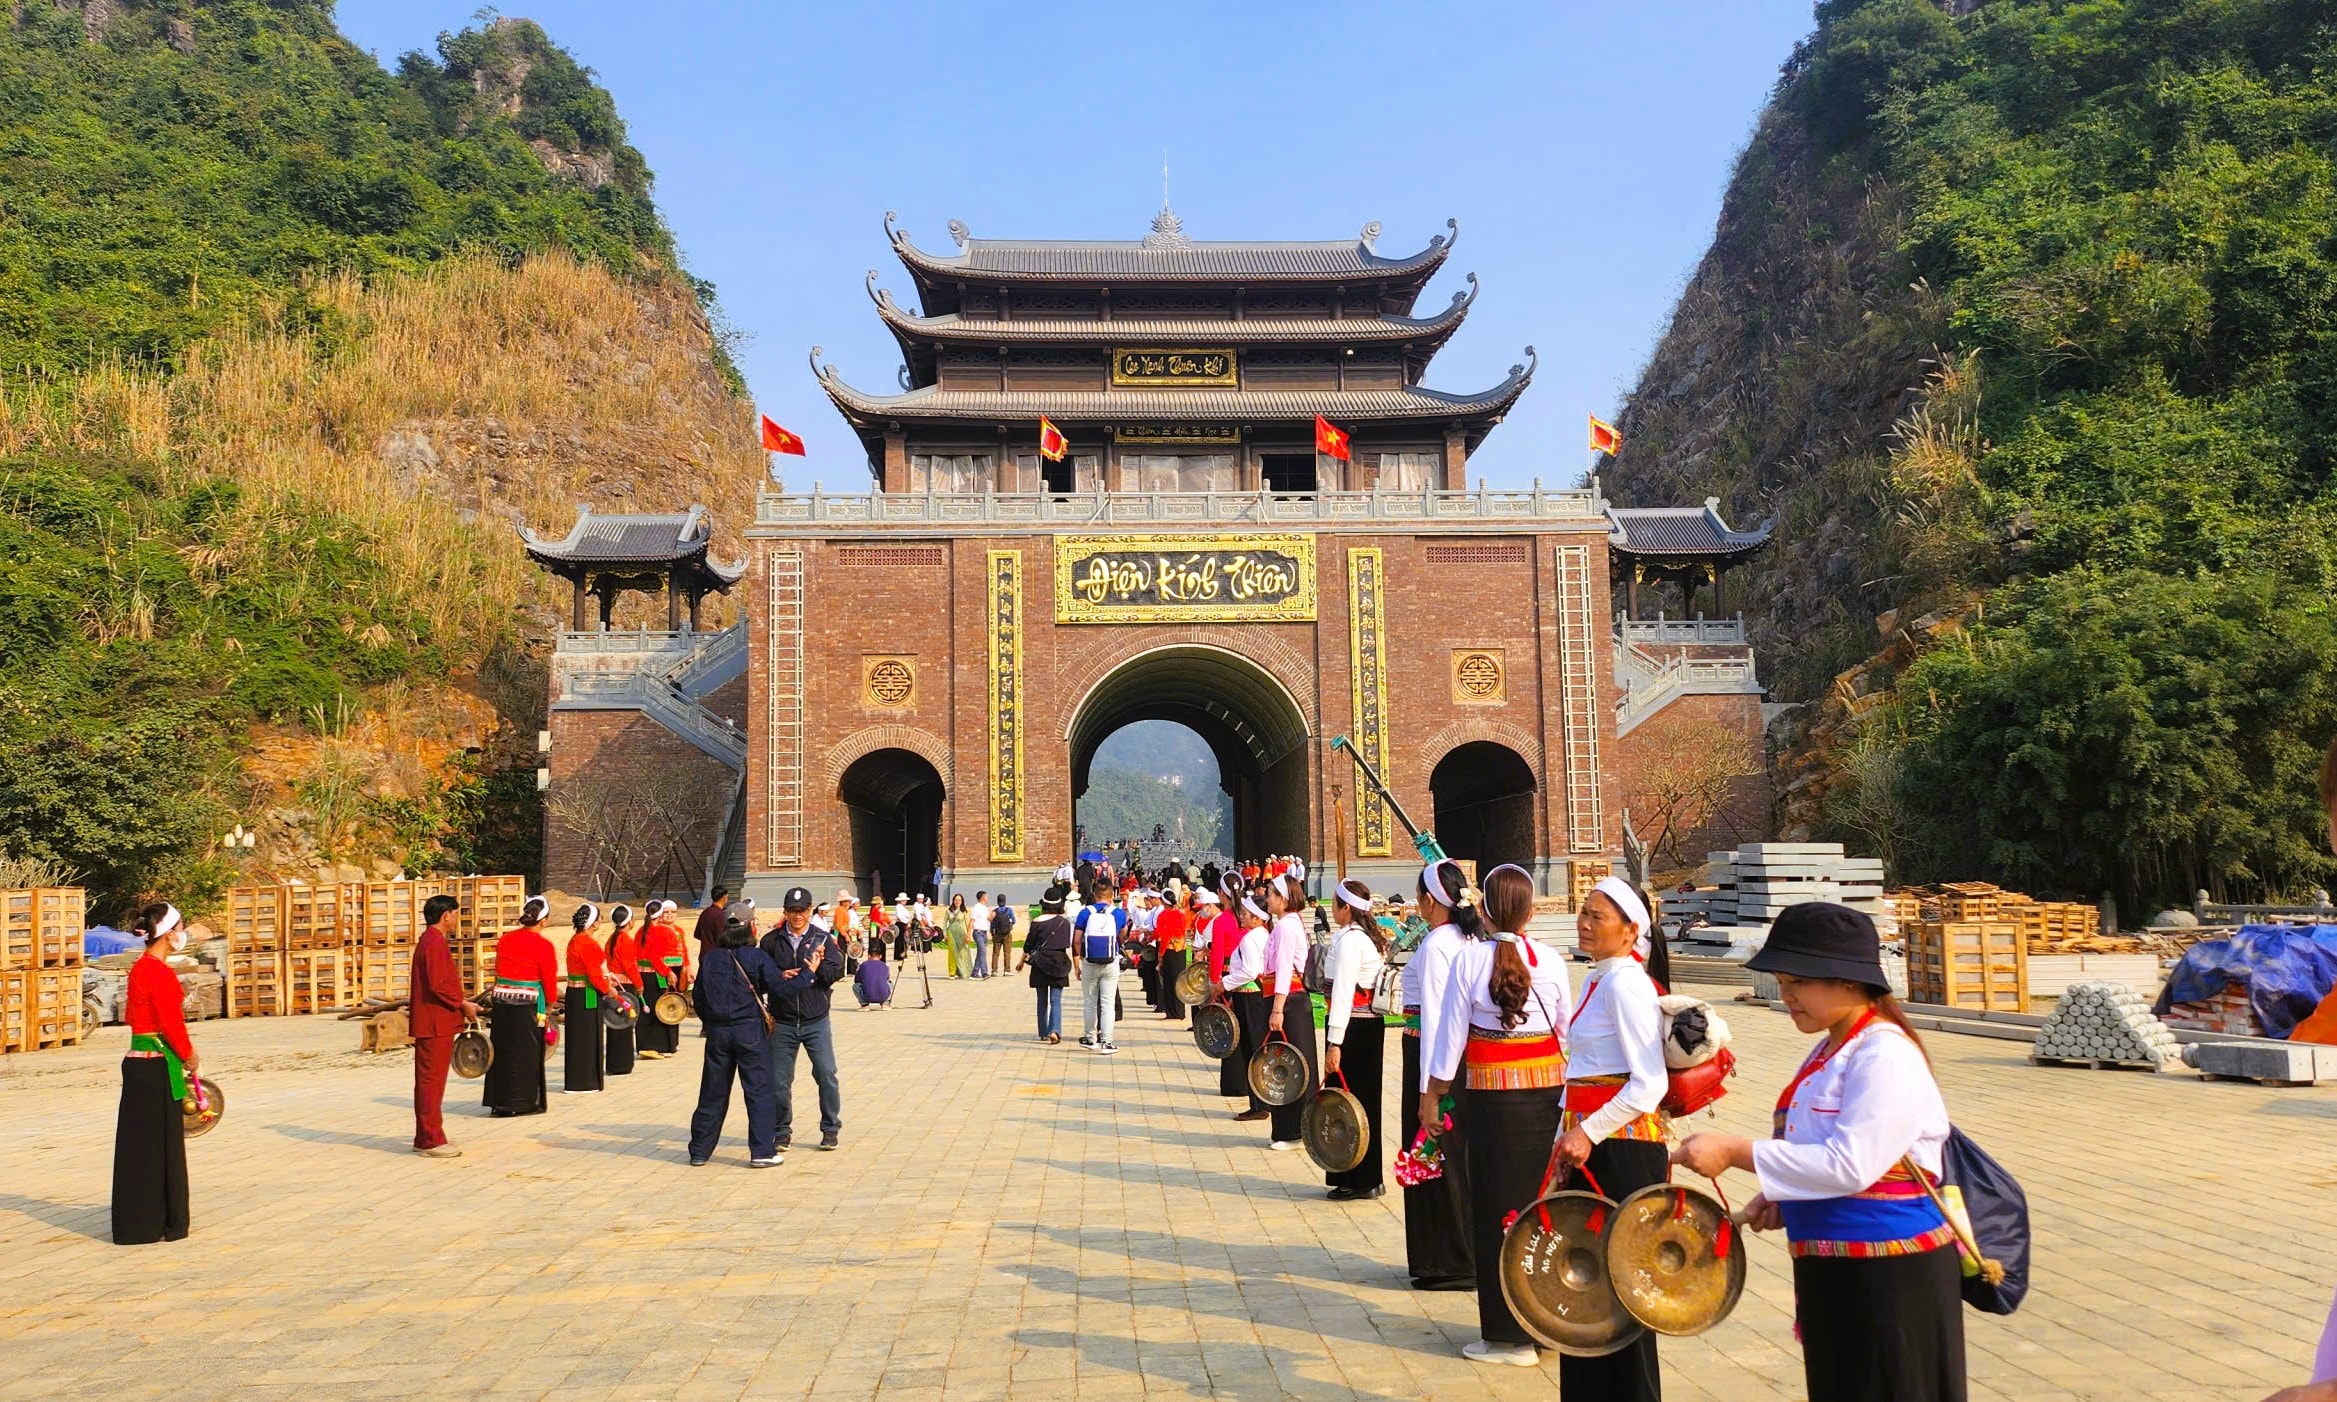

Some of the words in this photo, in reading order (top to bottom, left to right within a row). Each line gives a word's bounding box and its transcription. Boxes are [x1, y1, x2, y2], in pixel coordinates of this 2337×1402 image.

[1075, 557, 1151, 603] Điện
[1156, 554, 1219, 600] Kính
[1223, 555, 1295, 599] Thiên
